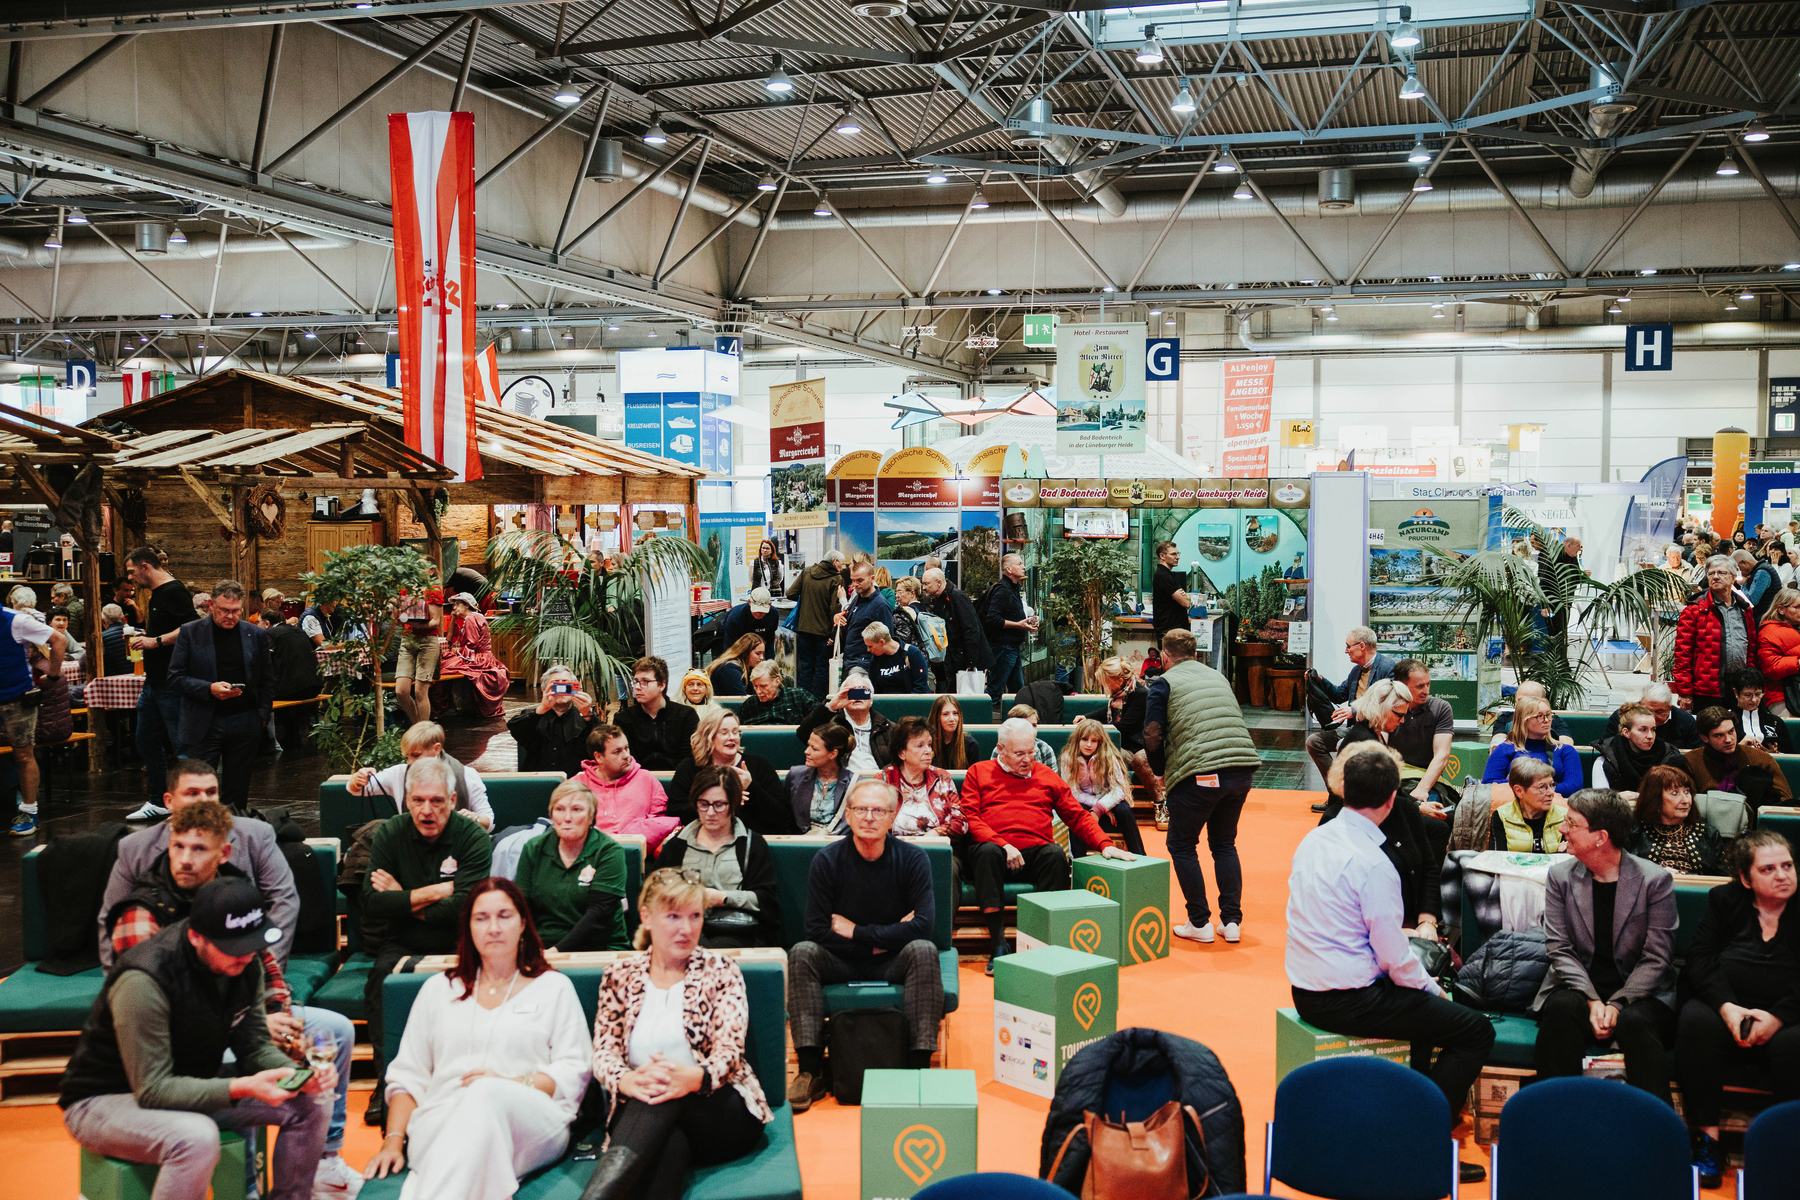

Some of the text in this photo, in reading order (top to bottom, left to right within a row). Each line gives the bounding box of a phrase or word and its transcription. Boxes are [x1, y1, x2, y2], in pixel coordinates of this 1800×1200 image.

[728, 339, 739, 356] 4
[1636, 330, 1662, 366] H
[1146, 342, 1172, 376] G
[1230, 364, 1268, 373] ALPenjoy
[72, 365, 90, 391] D
[1235, 378, 1264, 387] MESSE
[1230, 386, 1269, 396] ANGEBOT
[1240, 412, 1264, 420] Woche
[1236, 422, 1254, 430] 1.150
[830, 452, 869, 476] Sächsische
[882, 448, 924, 475] Sächsische
[1227, 455, 1258, 463] Spezialist
[1225, 462, 1267, 470] Sommerurlaub
[1040, 488, 1058, 498] Bad
[1060, 488, 1108, 498] Bodenteich
[1169, 488, 1267, 500] in der Lüneburger Heide
[1412, 486, 1536, 498] Star Clis Keuzfahrten
[1541, 509, 1577, 520] SEGELN
[1368, 532, 1384, 541] 4H46
[1399, 526, 1450, 538] NATURCAMP
